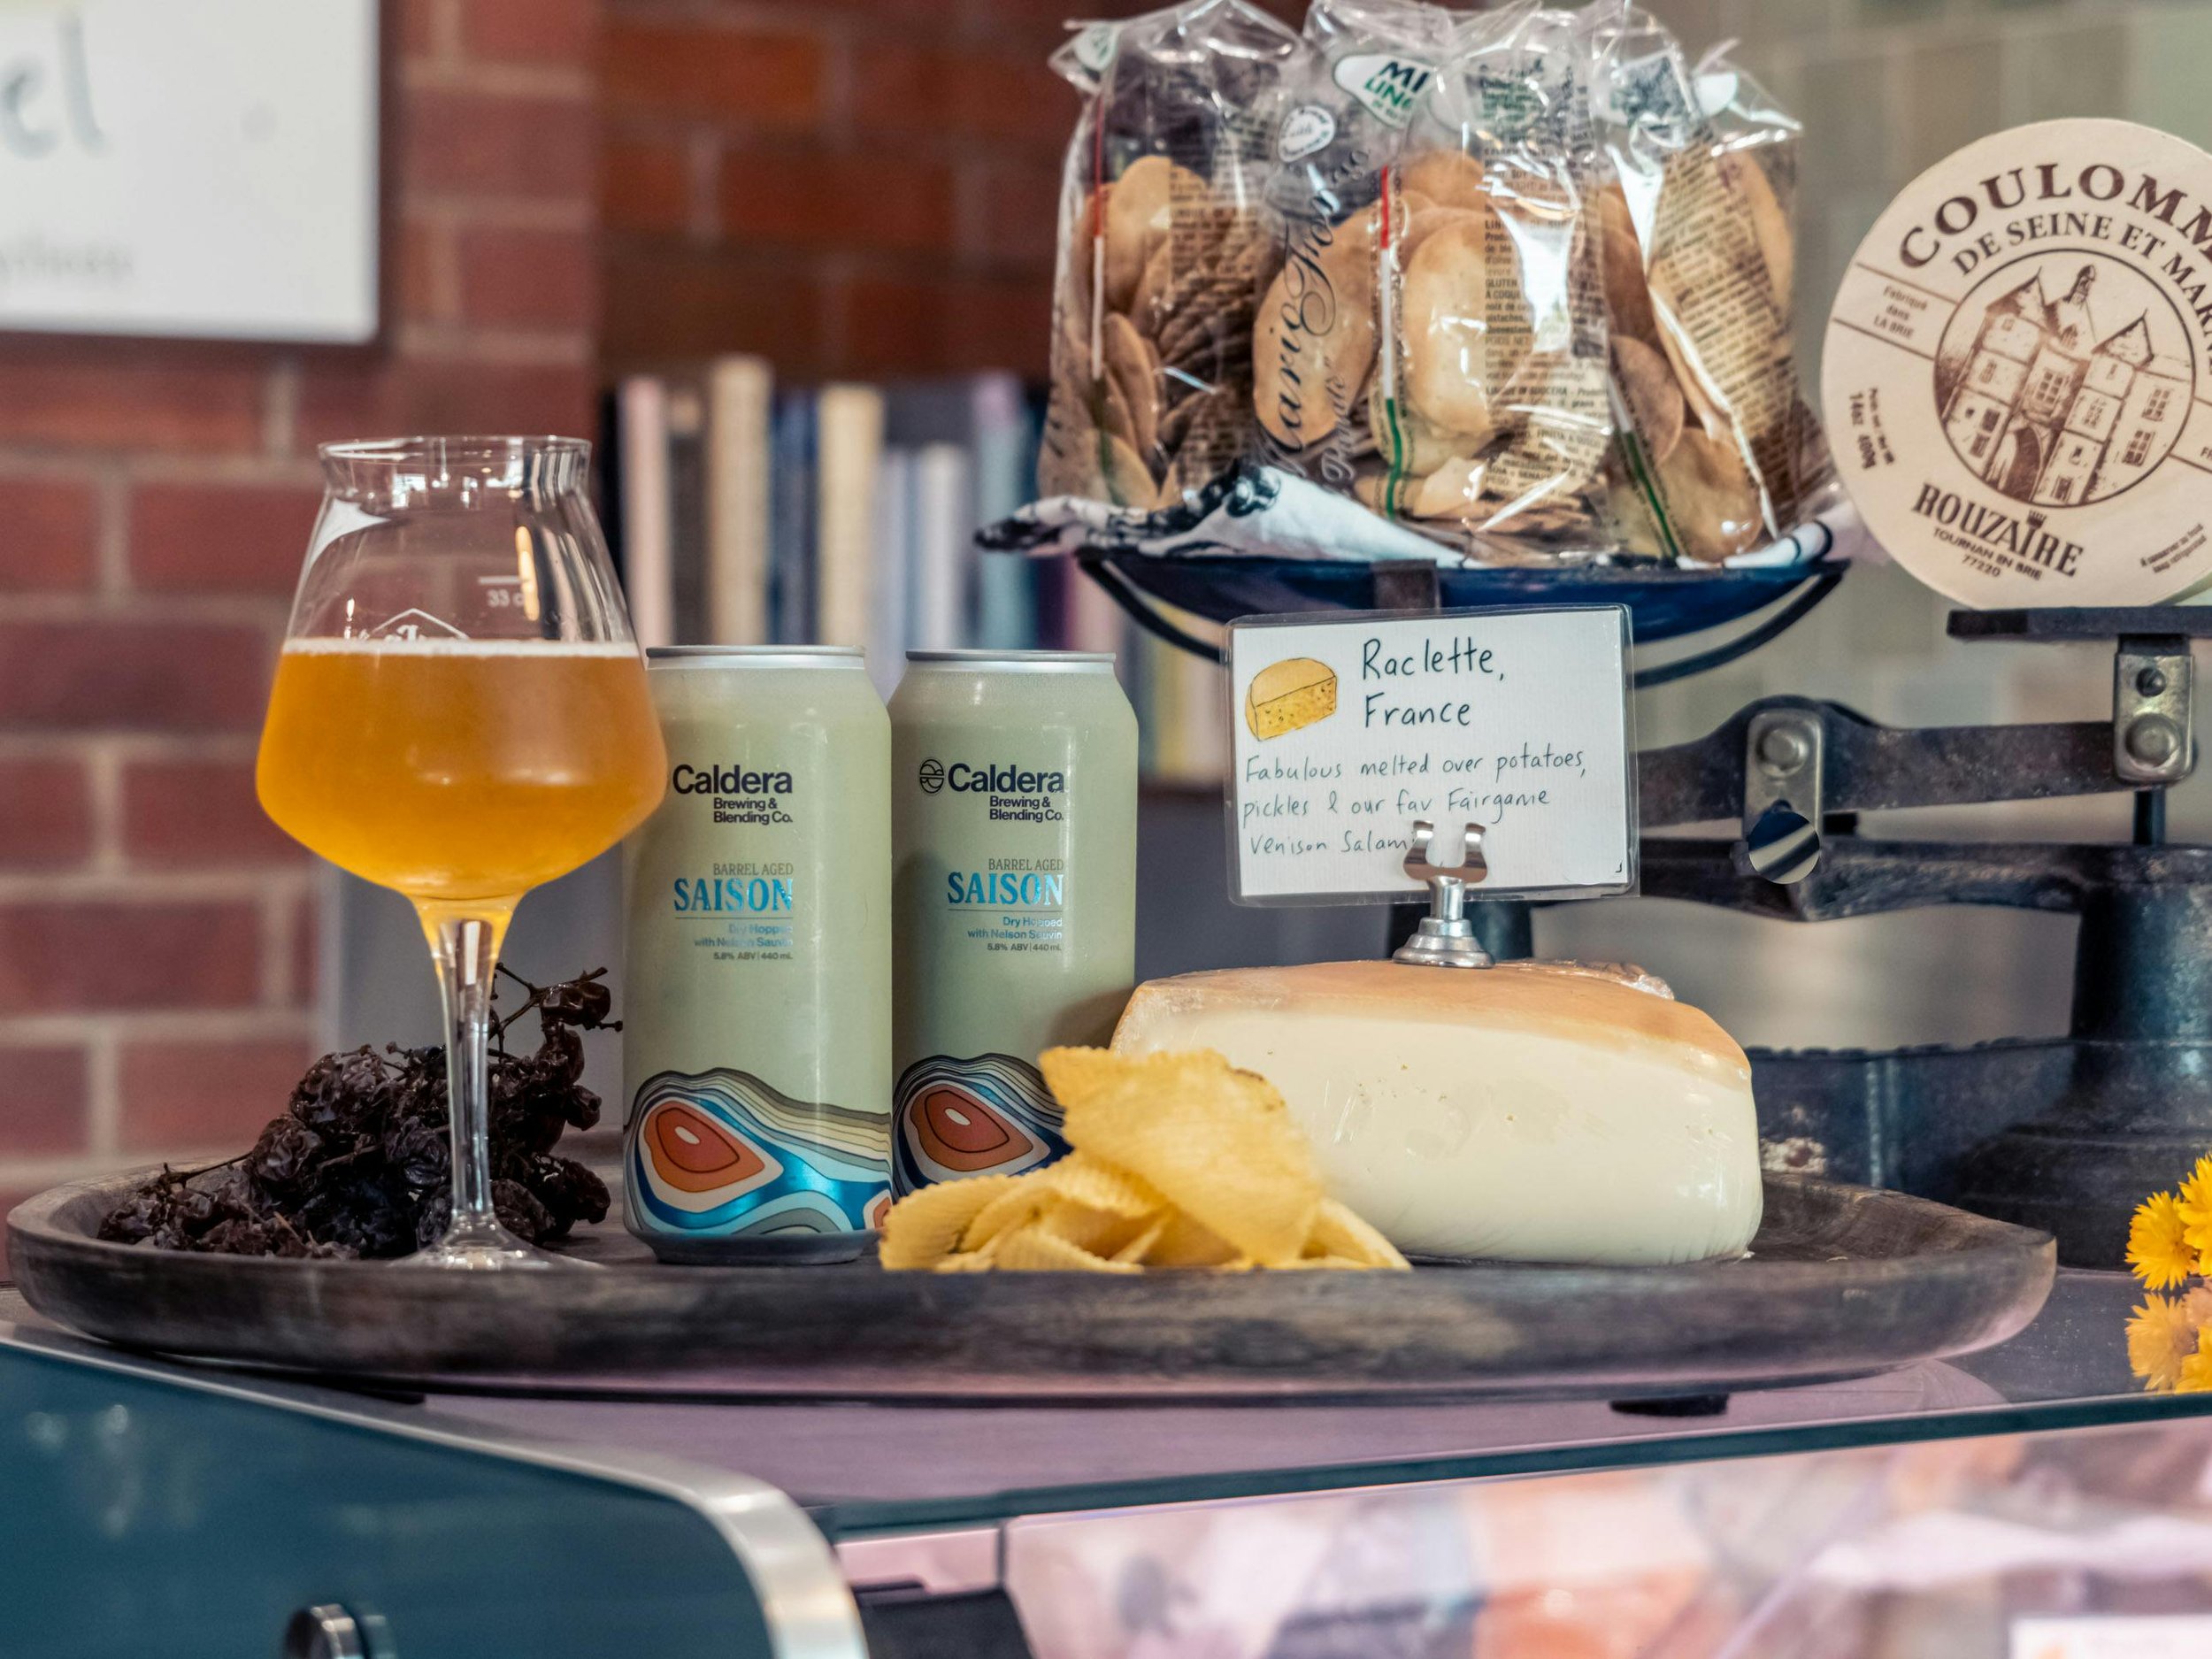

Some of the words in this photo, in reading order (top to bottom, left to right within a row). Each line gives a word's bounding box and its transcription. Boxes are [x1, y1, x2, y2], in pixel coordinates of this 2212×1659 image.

[1952, 232, 2001, 276] DE
[2006, 211, 2113, 246] SEINE
[2118, 224, 2165, 258] ET
[1932, 527, 1994, 560] TOURNAN
[1995, 554, 2015, 570] EN
[2016, 562, 2043, 581] BRIE
[1961, 554, 2001, 579] 77220
[488, 589, 510, 608] 33
[1363, 636, 1505, 681] Raclette,
[1364, 692, 1471, 729] France
[1246, 754, 1342, 782] Fabulous
[1360, 752, 1430, 777] melted
[1442, 757, 1484, 774] over
[1496, 741, 1586, 784] potatoes,
[672, 764, 793, 795] Caldera
[948, 763, 1064, 794] Caldera
[713, 797, 766, 811] Brewing
[768, 797, 778, 810] &
[989, 795, 1041, 810] Brewing
[1042, 796, 1051, 808] &
[1243, 793, 1310, 829] pickles
[1350, 799, 1386, 816] our
[1397, 788, 1433, 816] fav
[713, 810, 770, 826] Blending
[772, 810, 793, 824] Co.
[989, 809, 1043, 823] Blending
[1045, 809, 1064, 821] Co.
[713, 863, 759, 876] BARREL
[761, 863, 794, 876] AGED
[988, 858, 1033, 871] BARREL
[1034, 858, 1064, 871] AGED
[673, 878, 794, 912] SAISON
[947, 872, 1064, 906] SAISON
[967, 929, 989, 940] with
[990, 929, 1027, 940] Nelson
[1002, 917, 1021, 928] Dry
[987, 942, 1009, 952] 5.8%
[1010, 942, 1029, 951] ABV
[1032, 942, 1049, 951] 440
